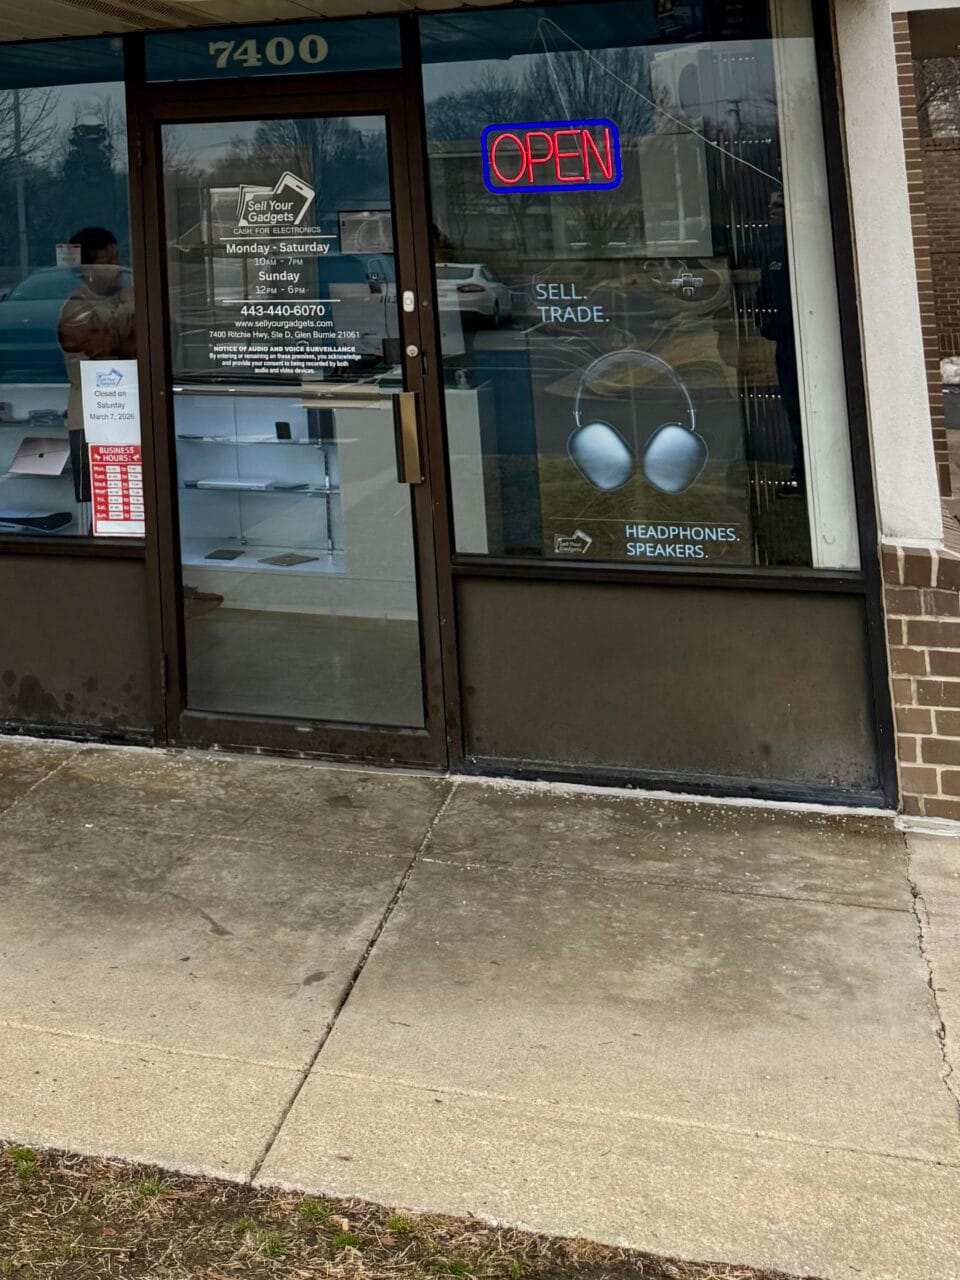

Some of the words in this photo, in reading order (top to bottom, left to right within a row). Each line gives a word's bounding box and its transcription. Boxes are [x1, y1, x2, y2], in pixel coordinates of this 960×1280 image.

[208, 34, 328, 69] 7400
[490, 127, 614, 185] OPEN
[248, 200, 267, 211] Sell
[269, 200, 294, 211] Your
[248, 212, 294, 224] Gadgets
[272, 226, 321, 234] ELECTRONICS
[226, 243, 270, 255] Monday
[279, 242, 330, 254] Saturday
[254, 258, 277, 266] 10AM
[288, 257, 303, 265] 7PM
[258, 271, 300, 282] Sunday
[255, 286, 277, 294] 12PM
[287, 286, 305, 294] 6PM
[536, 282, 587, 301] SELL.
[240, 305, 325, 316] 443-440-6070
[537, 305, 610, 323] TRADE.
[235, 320, 333, 329] www.sellyourgadgets.com
[97, 401, 125, 409] Saturday
[99, 446, 135, 454] BUSINESS
[102, 454, 131, 462] HOURS:
[625, 524, 740, 542] HEADPHONES.
[626, 542, 709, 559] SPEAKERS.
